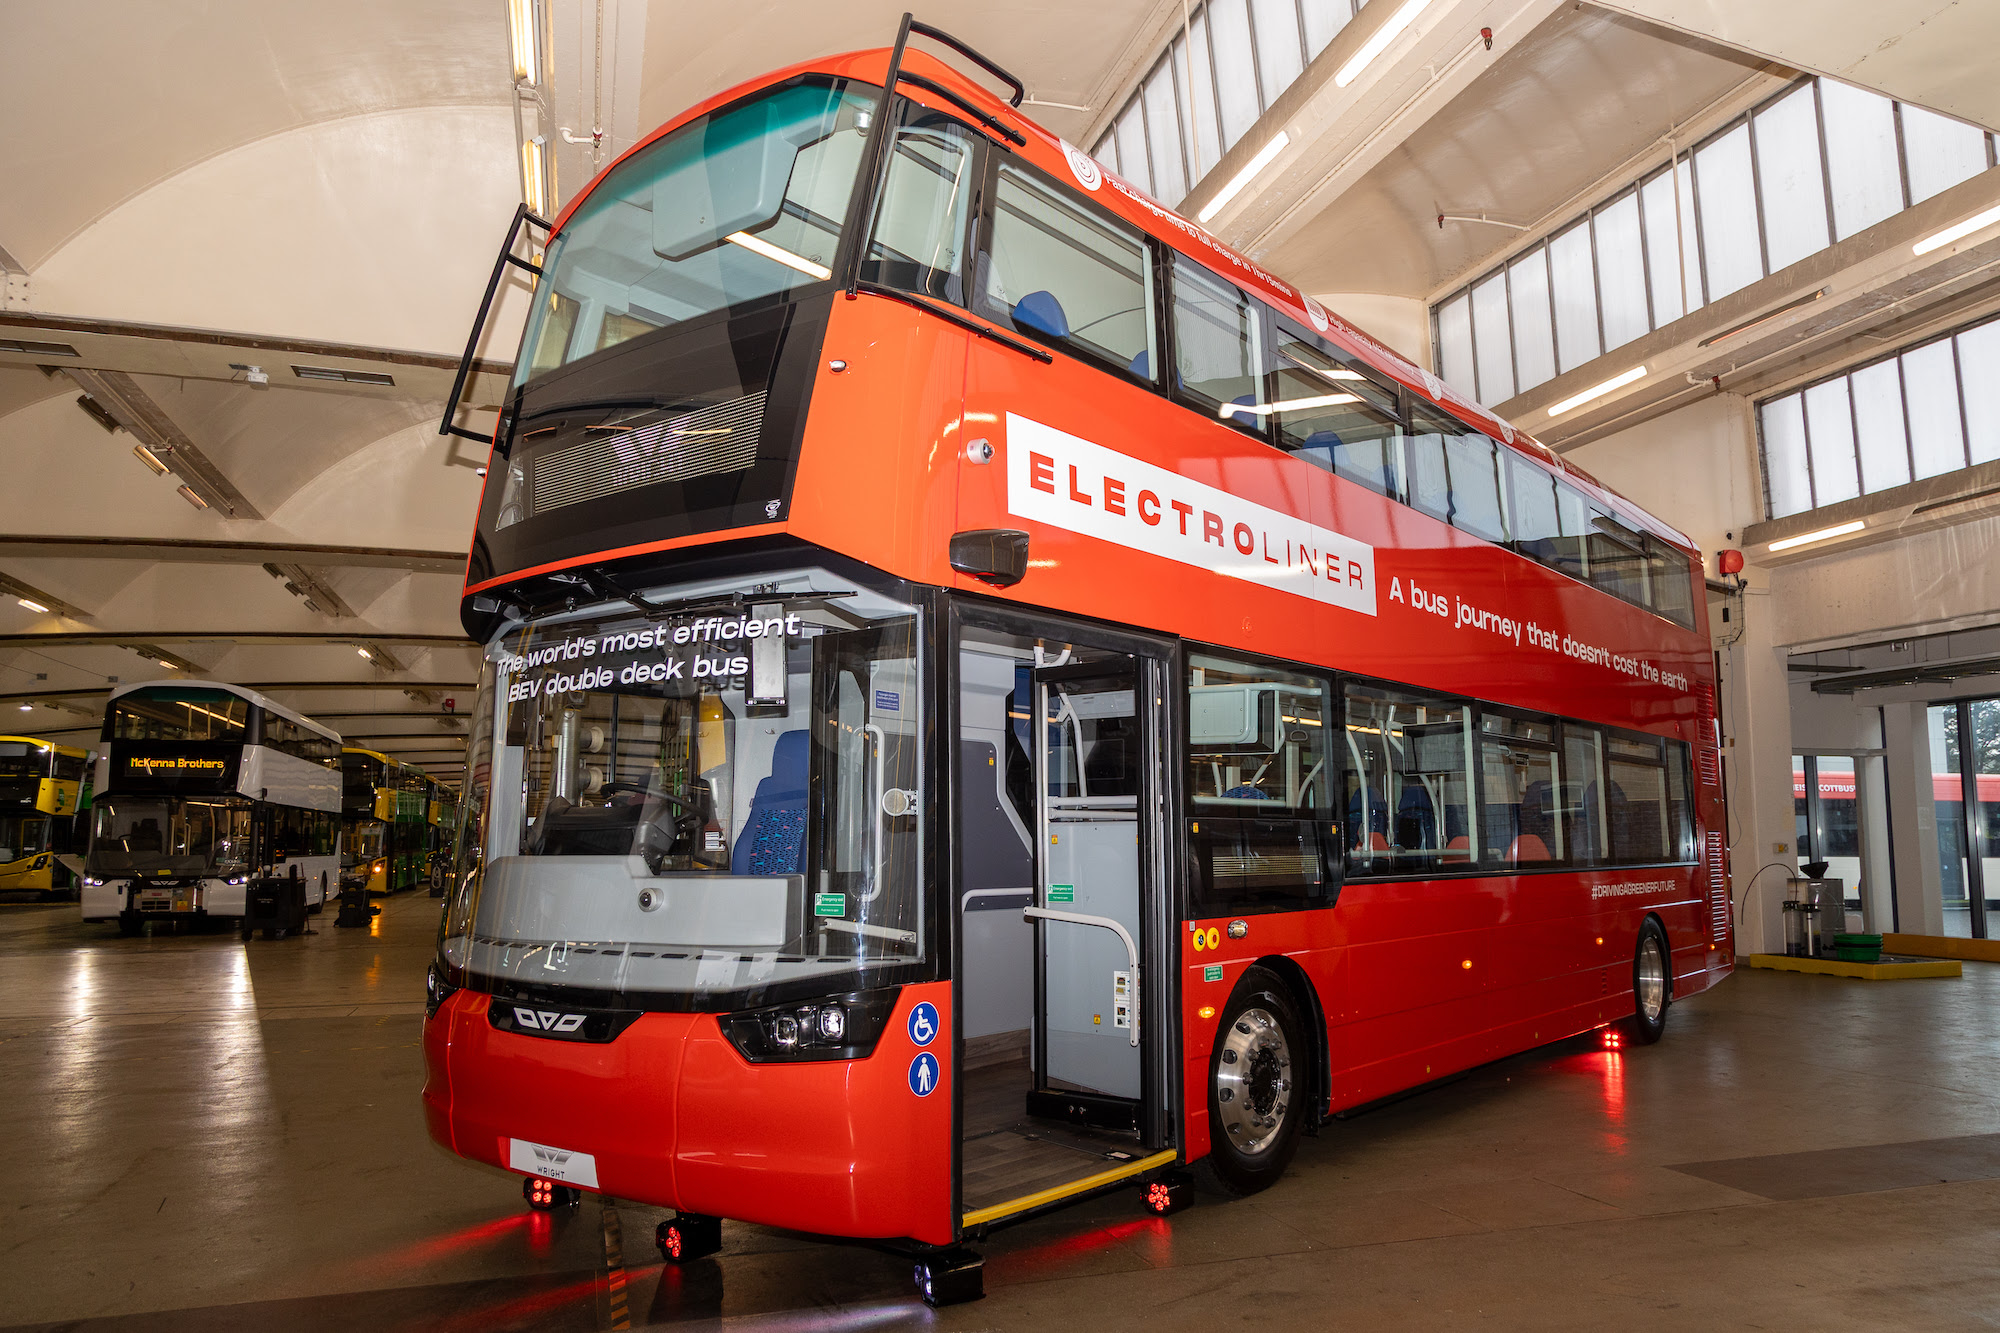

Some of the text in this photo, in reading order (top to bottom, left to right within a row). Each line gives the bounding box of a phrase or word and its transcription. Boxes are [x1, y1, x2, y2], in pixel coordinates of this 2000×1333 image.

[1104, 171, 1127, 196] Fast
[1127, 190, 1164, 217] charge
[1165, 210, 1186, 232] time
[1186, 221, 1197, 238] to
[1197, 228, 1213, 249] full
[1213, 240, 1243, 267] charge
[1242, 256, 1252, 272] in
[1029, 450, 1363, 591] ELECTROLINER
[496, 612, 801, 677] The world's most efficient
[1388, 576, 1689, 693] A bus journey that doesn't cost the earth
[508, 654, 749, 703] BEV double deck bus
[130, 757, 225, 769] McKenna Brothers
[1591, 880, 1676, 900] #DRIVINGAGREENERFUTURE
[537, 1165, 565, 1180] WRIGHT
